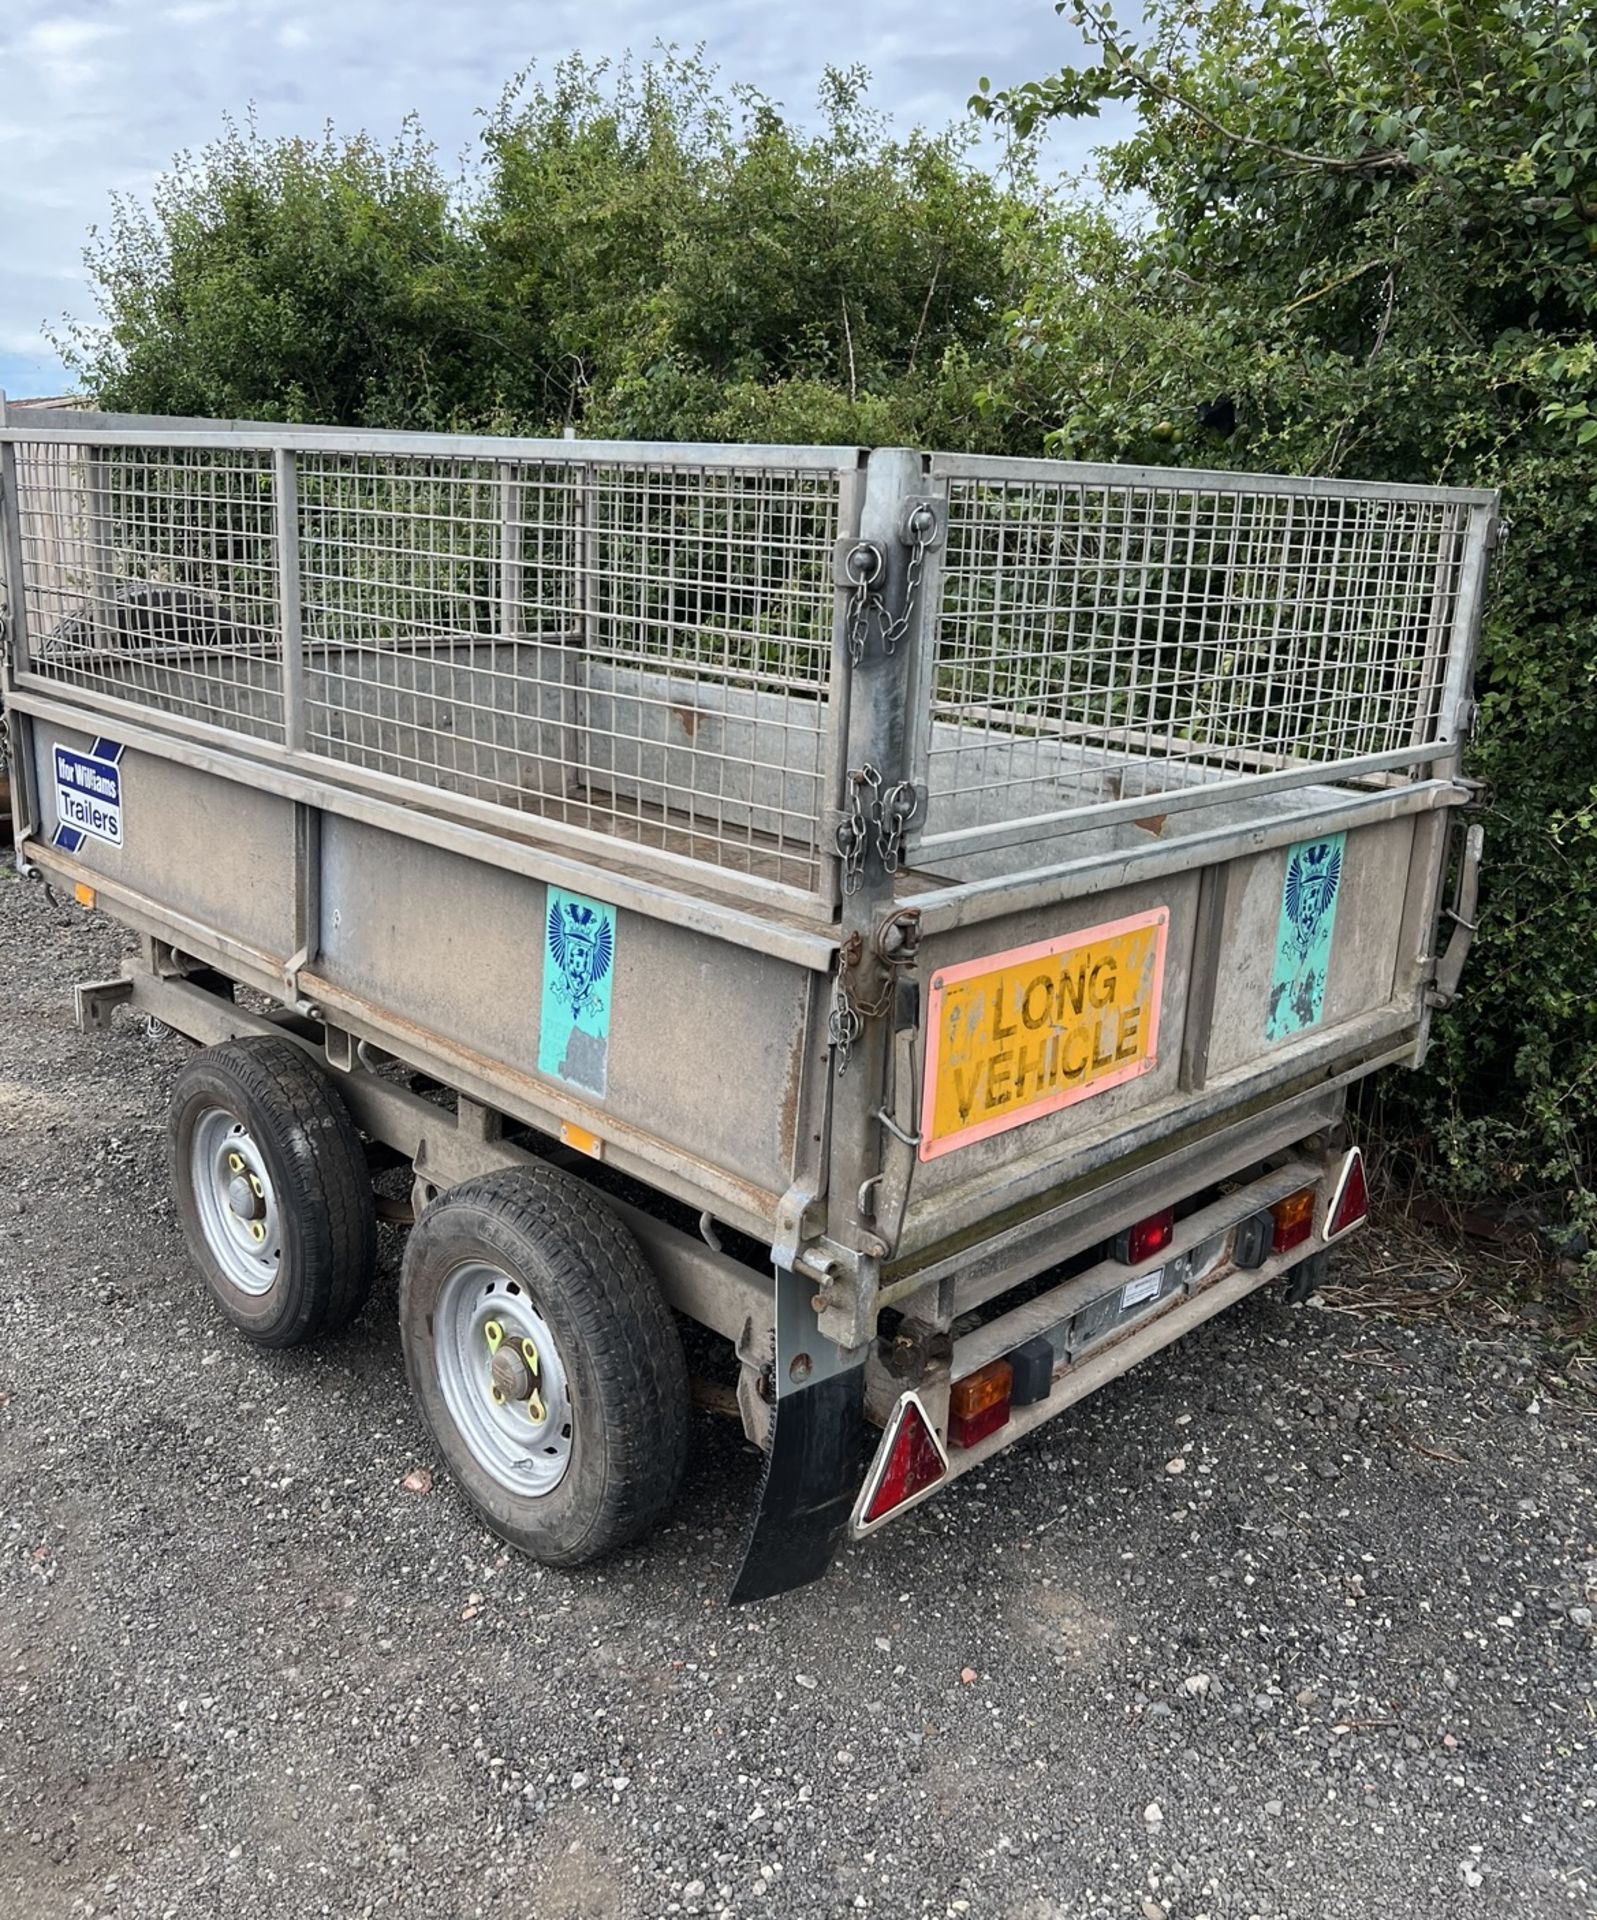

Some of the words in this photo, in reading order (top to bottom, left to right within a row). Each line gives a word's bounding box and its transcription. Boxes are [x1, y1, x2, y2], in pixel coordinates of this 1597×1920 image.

[75, 763, 117, 798] Williams
[61, 791, 118, 836] Trailers
[992, 956, 1118, 1040] LONG
[953, 1007, 1141, 1121] VEHICLE
